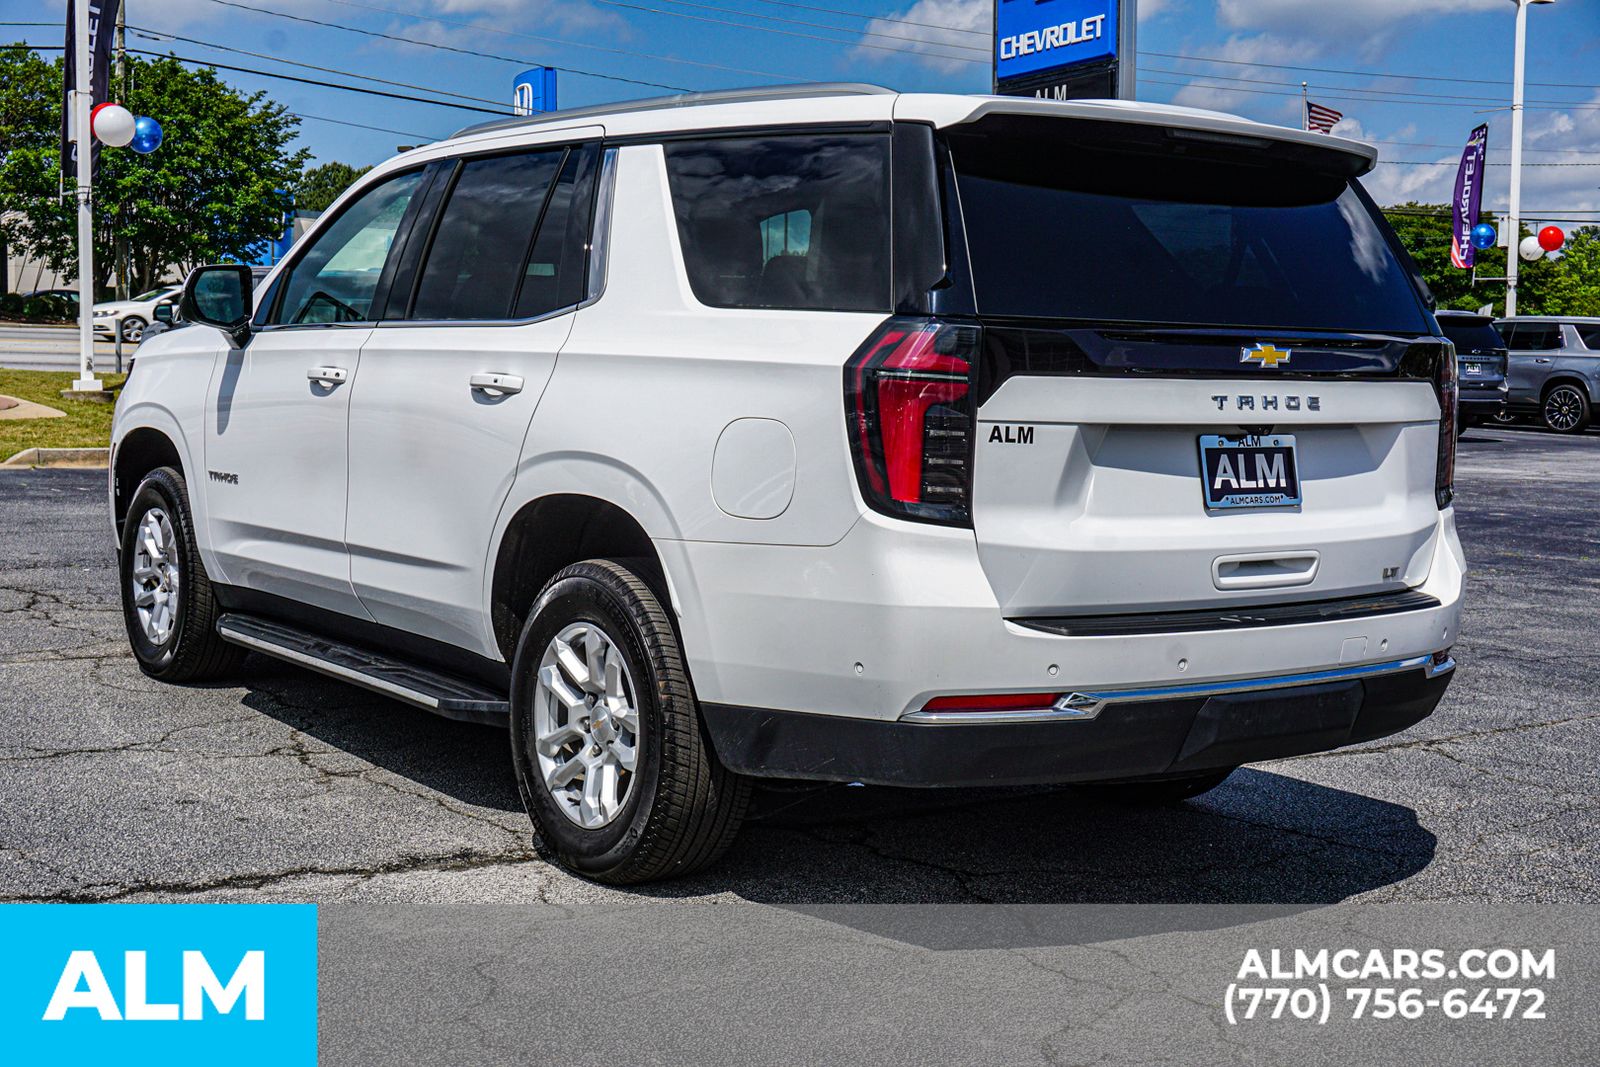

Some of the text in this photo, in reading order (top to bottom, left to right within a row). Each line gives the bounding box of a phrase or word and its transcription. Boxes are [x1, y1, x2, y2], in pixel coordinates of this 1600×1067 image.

[1000, 13, 1105, 60] CHEVROLET
[1459, 151, 1476, 260] CHEVROLET
[1211, 395, 1320, 411] TAHOE
[988, 425, 1034, 444] ALM
[1238, 435, 1261, 447] ALM
[1214, 454, 1287, 489] ALM
[1230, 495, 1281, 505] ALMCARS.COM
[1383, 566, 1400, 578] LT
